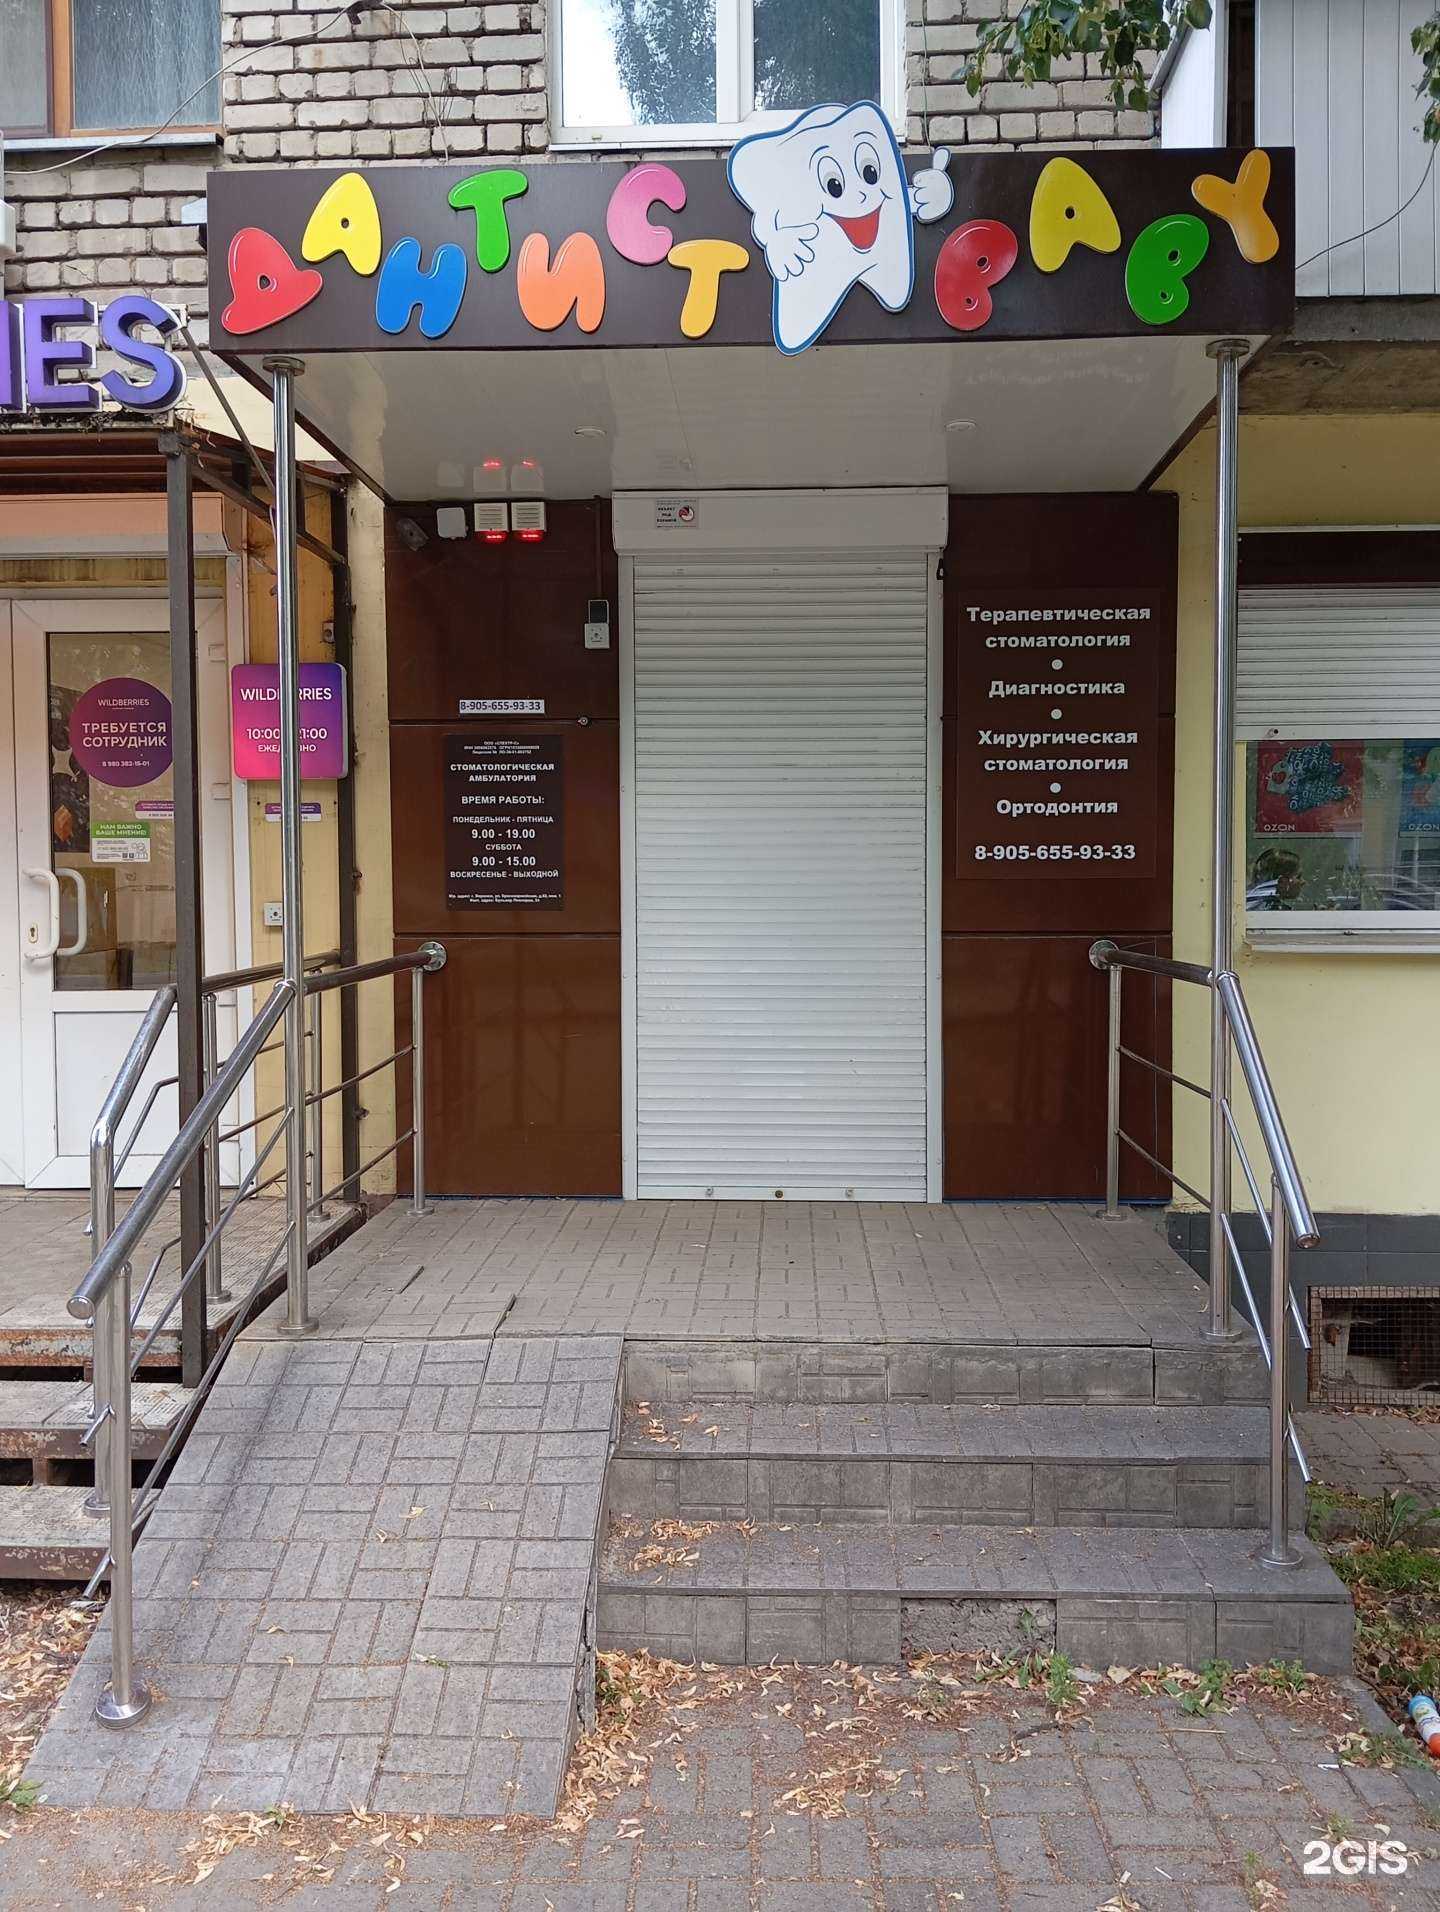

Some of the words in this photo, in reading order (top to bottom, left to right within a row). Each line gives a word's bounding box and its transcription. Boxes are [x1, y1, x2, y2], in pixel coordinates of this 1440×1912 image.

[221, 162, 750, 341] ДАНТИСТ
[966, 606, 1151, 625] Терапевтическая
[985, 634, 1131, 648] стоматология
[988, 680, 1126, 698] Диагностика
[97, 698, 150, 707] WILDBERRIES
[460, 701, 541, 711] 8-905-655-93-33
[82, 722, 167, 734] ТРЕБУЕТСЯ
[299, 728, 328, 740] 1:00
[978, 730, 1138, 748] Хирургическая
[82, 735, 168, 749] СОТРУДНИК
[450, 763, 555, 771] СТОМАТОЛОГИЧЕСКАЯ
[984, 758, 1129, 771] стоматология
[468, 774, 537, 783] АМБУЛАТОРИЯ
[461, 795, 496, 805] ВРЕМЯ
[498, 795, 545, 805] РАБОТЫ:
[996, 799, 1118, 817] Ортодонтия
[452, 816, 511, 824] ПОНЕДЕЛЬНИК
[516, 816, 554, 824] ПЯТНИЦА
[1263, 823, 1296, 832] OZON
[471, 828, 496, 839] 9.00
[505, 828, 536, 839] 19.00
[485, 843, 522, 851] СУББОТА
[974, 844, 1136, 860] 8-905-655-93-33
[472, 856, 496, 866] 9.00
[506, 856, 536, 866] 15.00
[513, 869, 559, 879] ВЫХОДНОЙ
